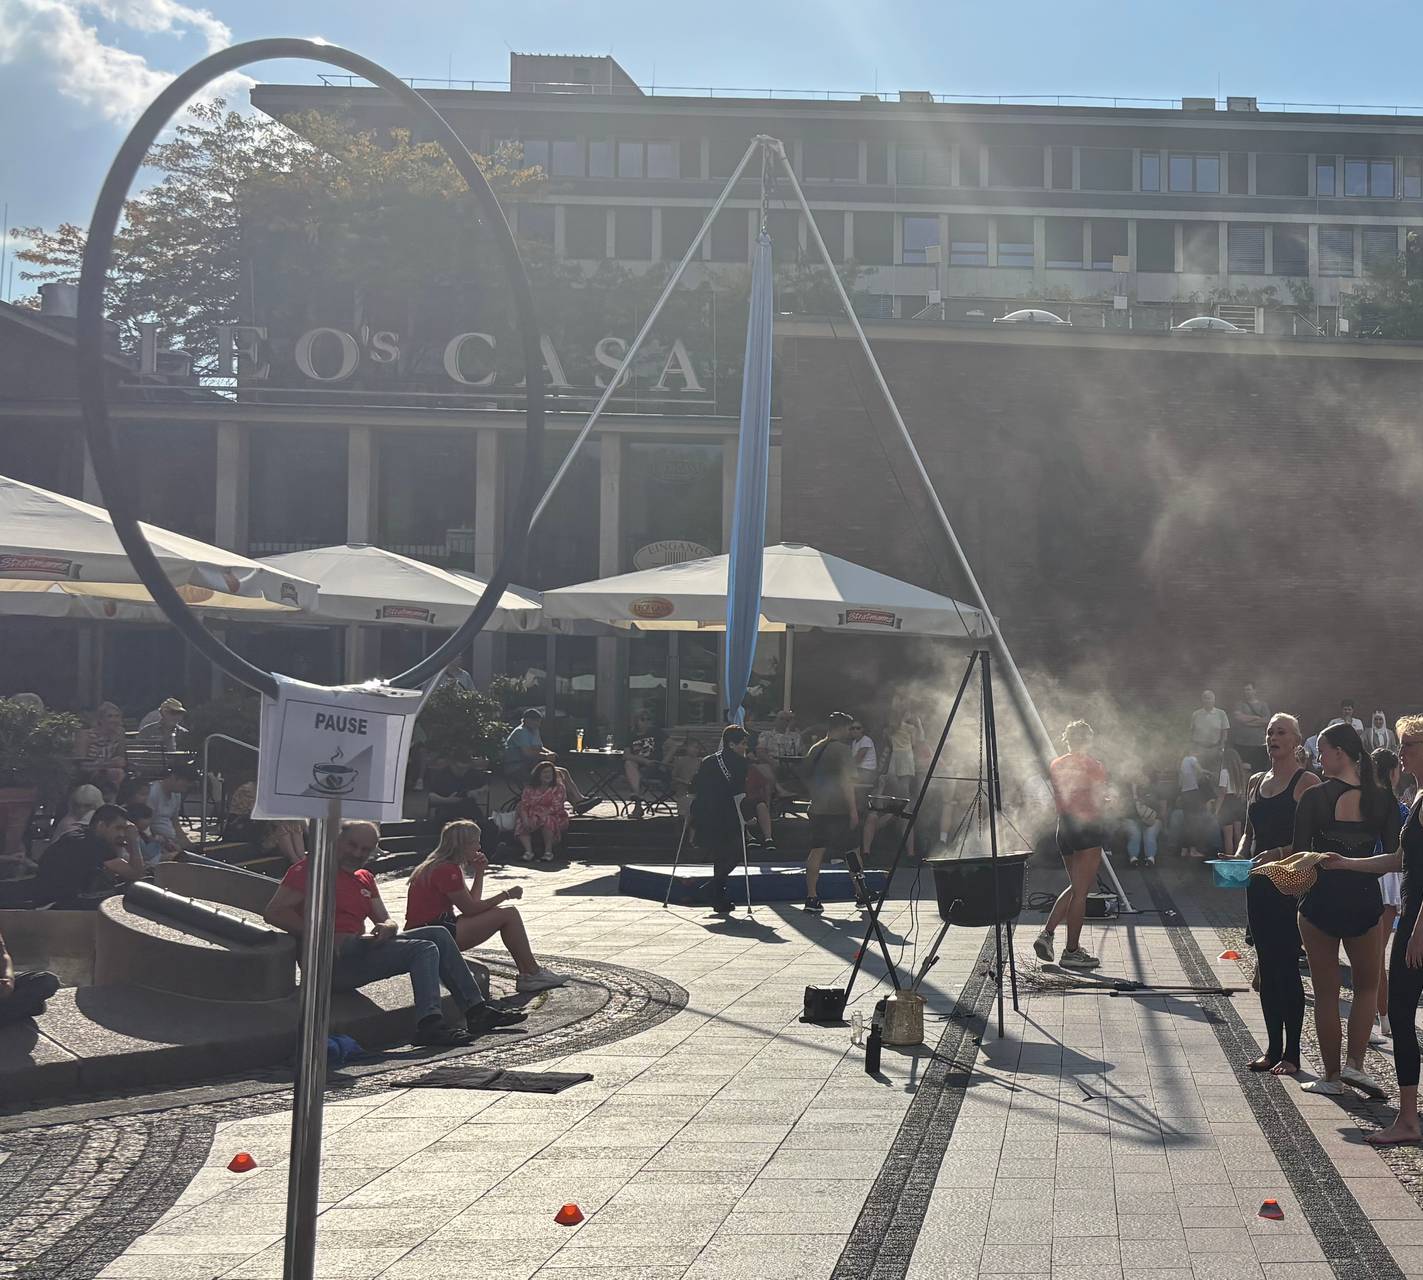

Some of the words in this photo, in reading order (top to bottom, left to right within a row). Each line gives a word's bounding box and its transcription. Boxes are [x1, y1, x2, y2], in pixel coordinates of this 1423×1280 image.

[443, 332, 706, 392] CASA
[647, 541, 703, 556] EINGANG
[314, 712, 369, 736] PAUSE
